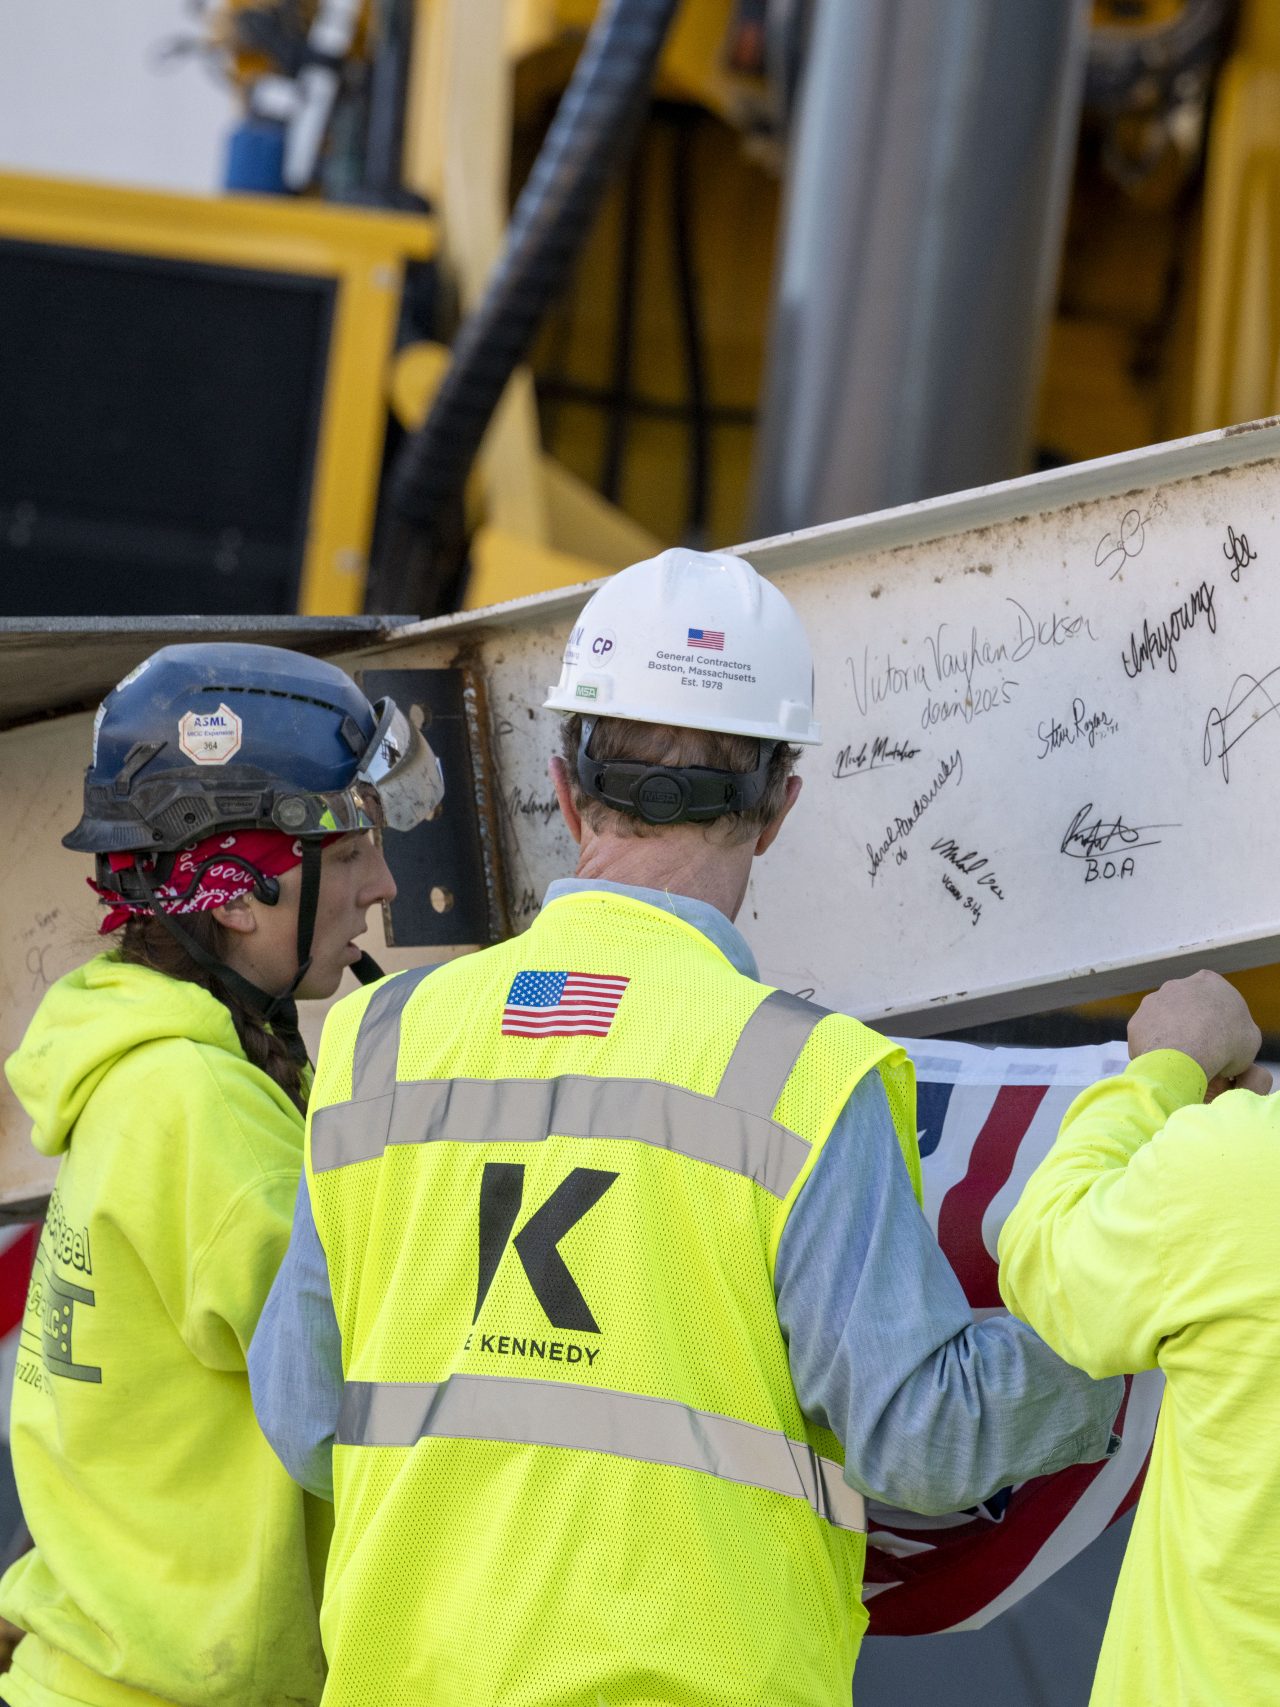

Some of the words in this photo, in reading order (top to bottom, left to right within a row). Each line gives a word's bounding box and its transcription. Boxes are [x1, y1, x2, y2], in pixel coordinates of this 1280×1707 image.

[592, 636, 613, 656] CP
[656, 650, 694, 663] General
[696, 655, 752, 671] Contractors
[648, 660, 686, 674] Boston,
[688, 665, 757, 683] Massachusetts
[576, 686, 597, 698] MSA
[681, 677, 699, 687] Est.
[701, 679, 724, 691] 1978
[194, 716, 227, 727] ASML
[480, 1334, 601, 1367] KENNEDY
